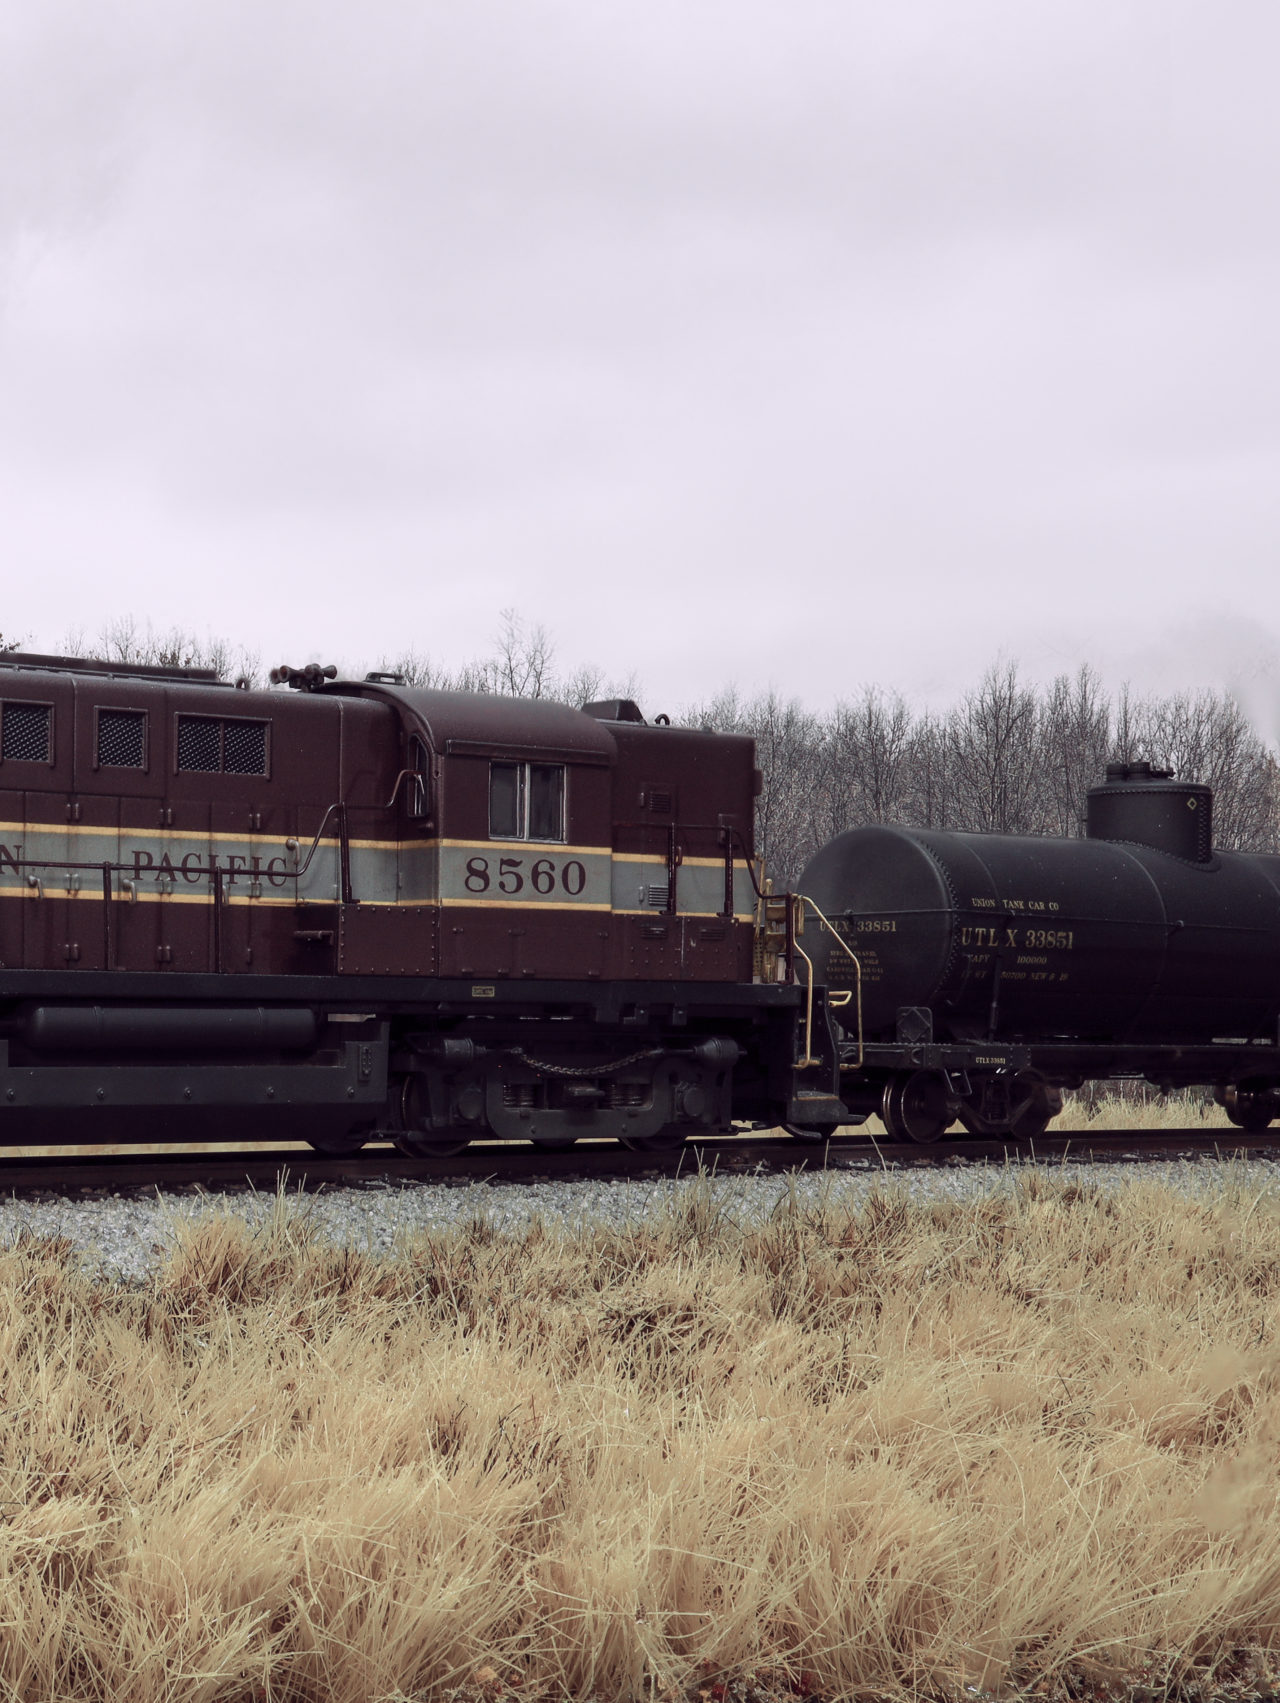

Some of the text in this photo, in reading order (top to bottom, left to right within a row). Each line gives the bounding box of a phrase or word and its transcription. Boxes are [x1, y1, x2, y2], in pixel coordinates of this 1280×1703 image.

[131, 850, 287, 887] PACIFIC
[465, 857, 586, 895] 8560
[971, 898, 1060, 911] UNION TANK CAR CO
[857, 920, 897, 932] 33851
[1025, 930, 1073, 949] 33851
